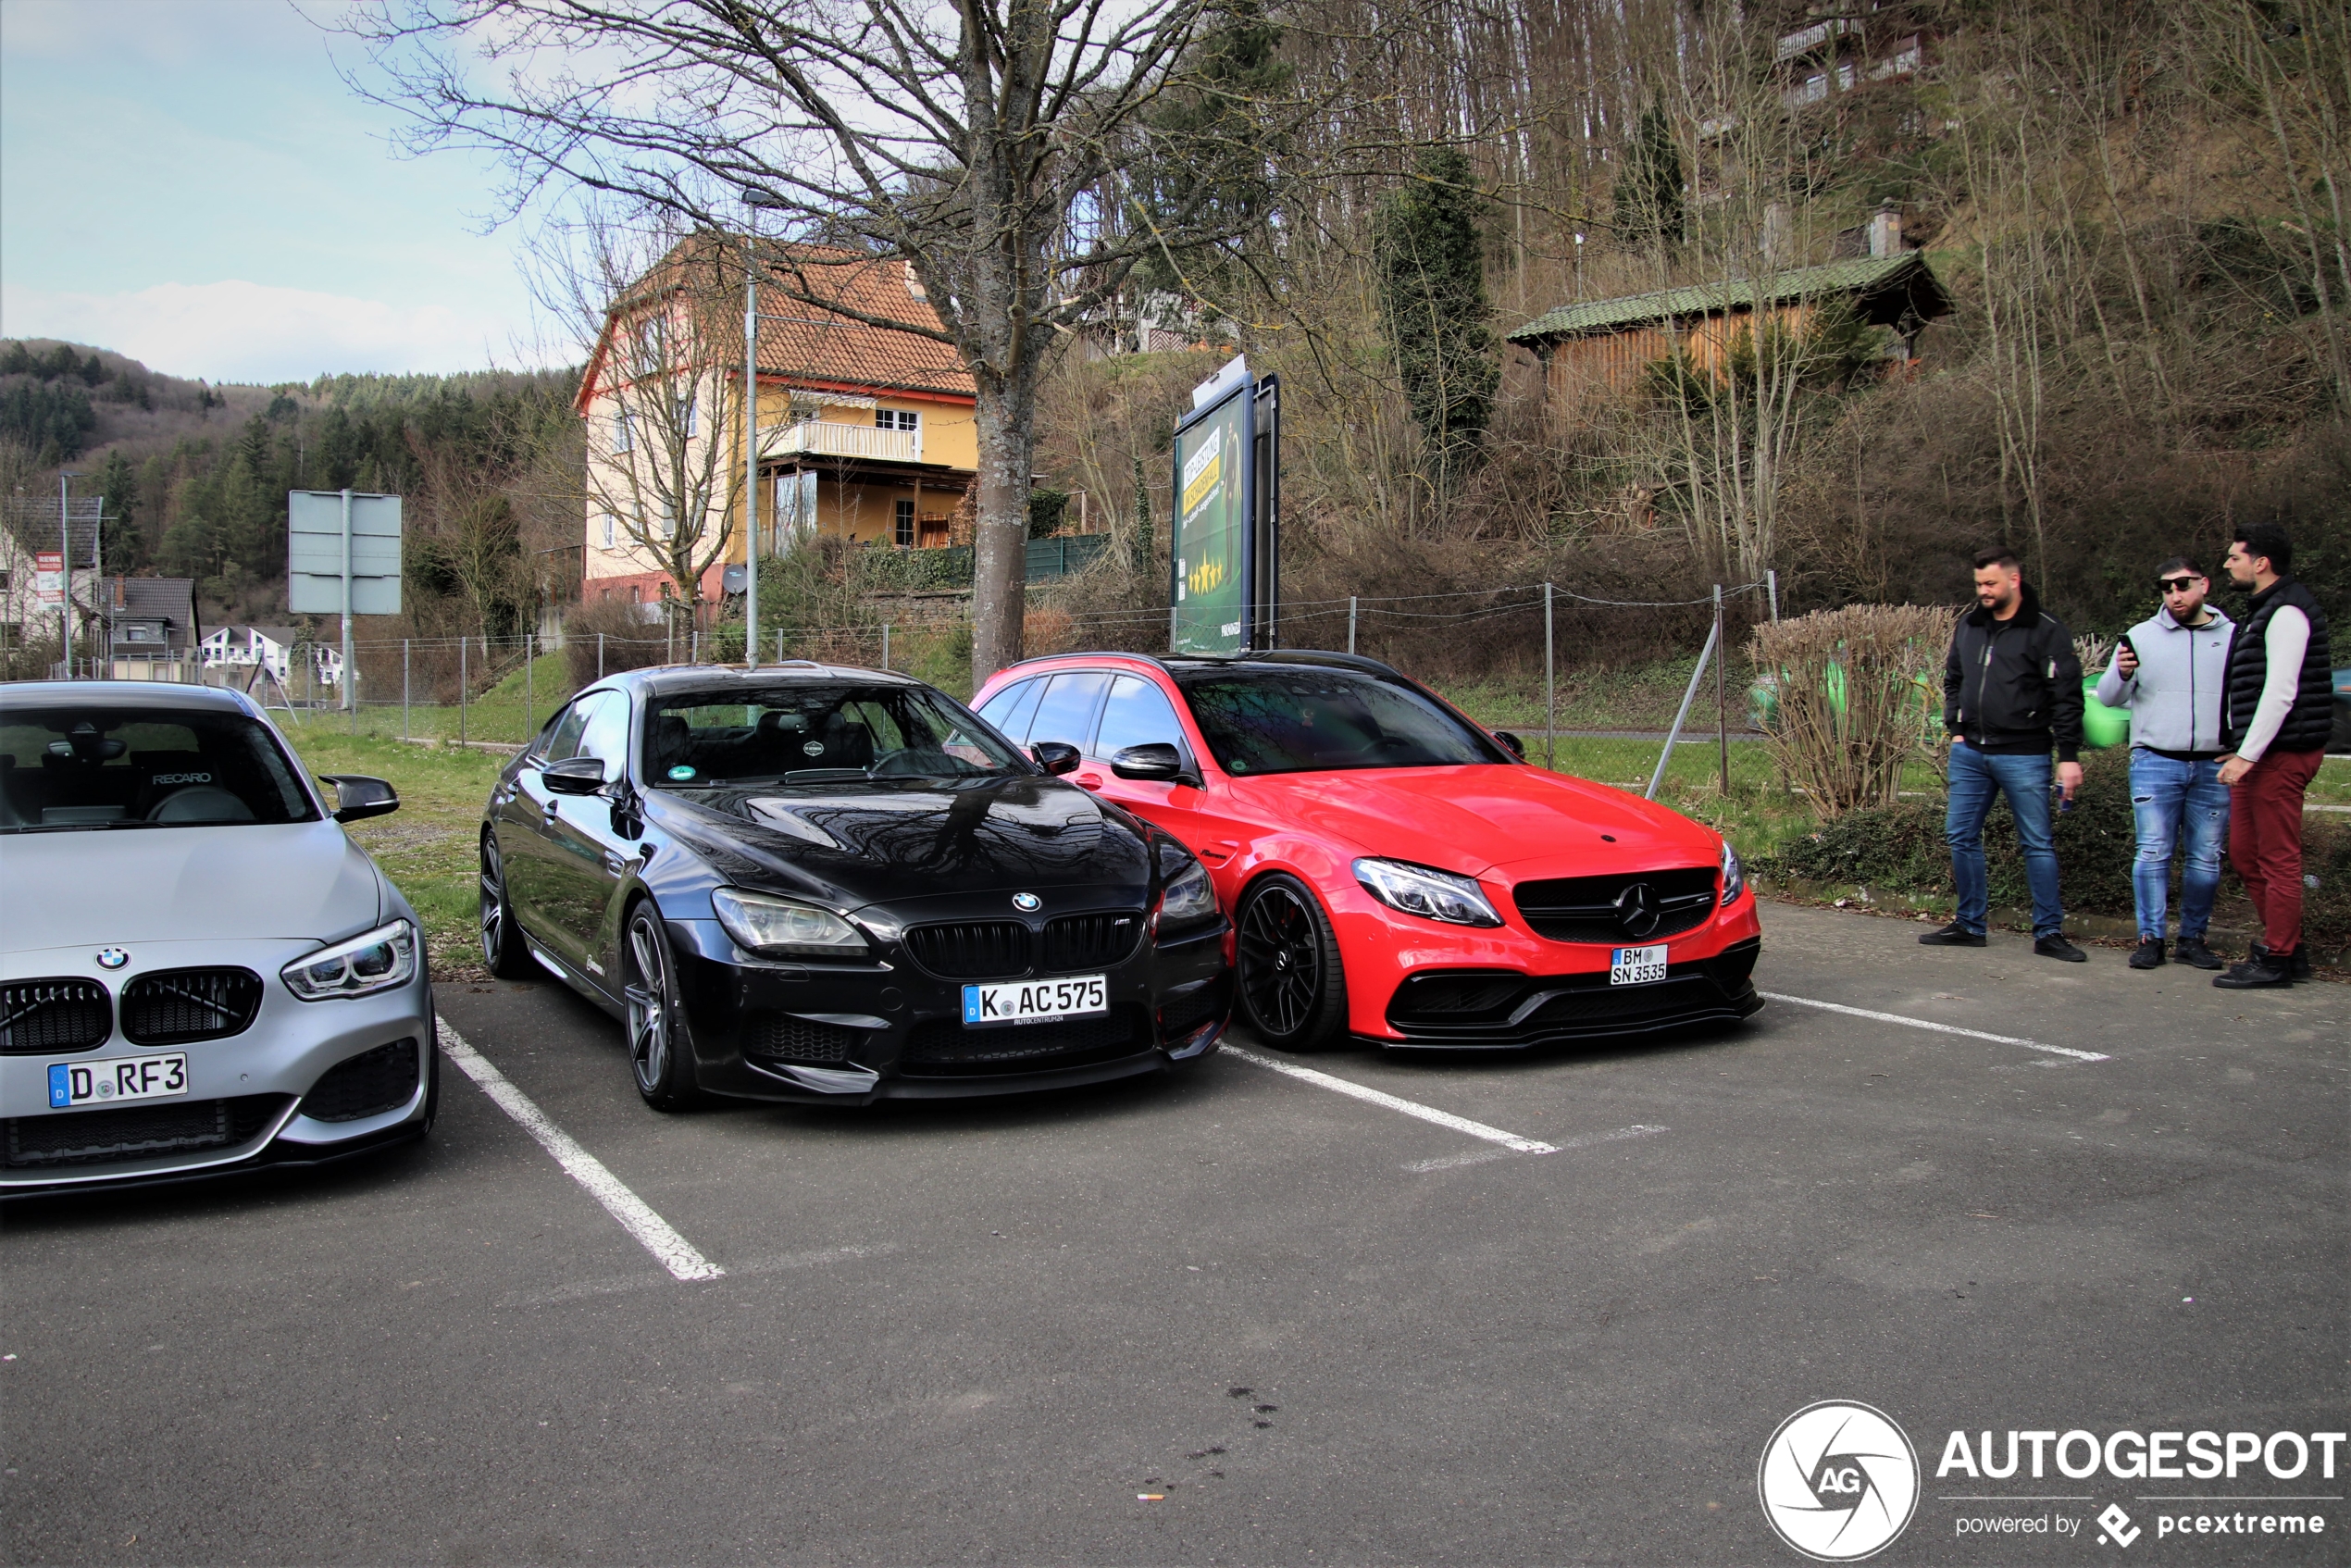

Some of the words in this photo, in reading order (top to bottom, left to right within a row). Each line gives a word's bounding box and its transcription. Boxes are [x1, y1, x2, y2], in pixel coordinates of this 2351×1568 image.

[153, 772, 212, 785] RECARO
[1623, 949, 1642, 964] BM
[1612, 967, 1632, 983] SN
[1634, 964, 1665, 982] 3535
[969, 1007, 976, 1016] D
[981, 989, 999, 1016] K
[1014, 1015, 1064, 1026] AUTOCENTRUM24
[56, 1089, 64, 1100] D
[70, 1067, 93, 1100] D
